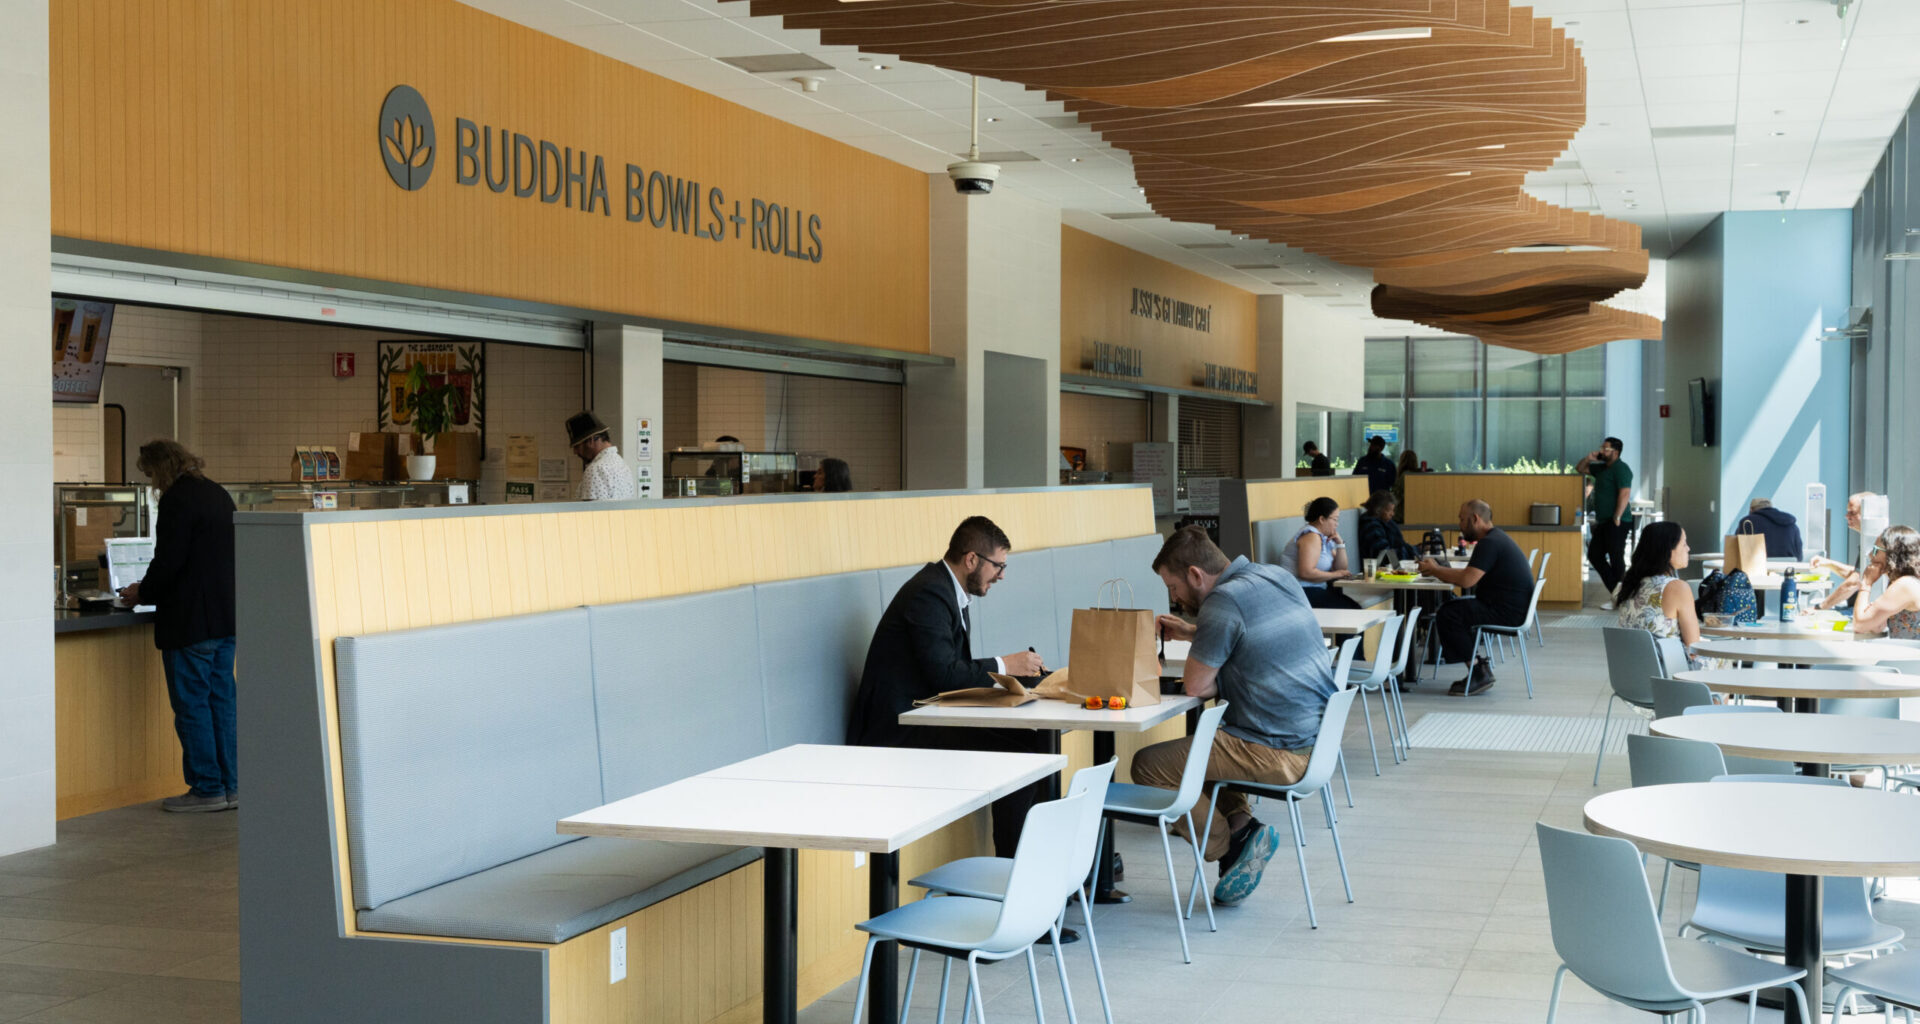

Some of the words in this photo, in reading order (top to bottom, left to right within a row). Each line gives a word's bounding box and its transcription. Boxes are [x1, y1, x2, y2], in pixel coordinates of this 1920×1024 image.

[456, 117, 611, 216] BUDDHA
[1094, 341, 1113, 373] THE
[1114, 345, 1144, 376] GRILL
[510, 486, 529, 494] PASS
